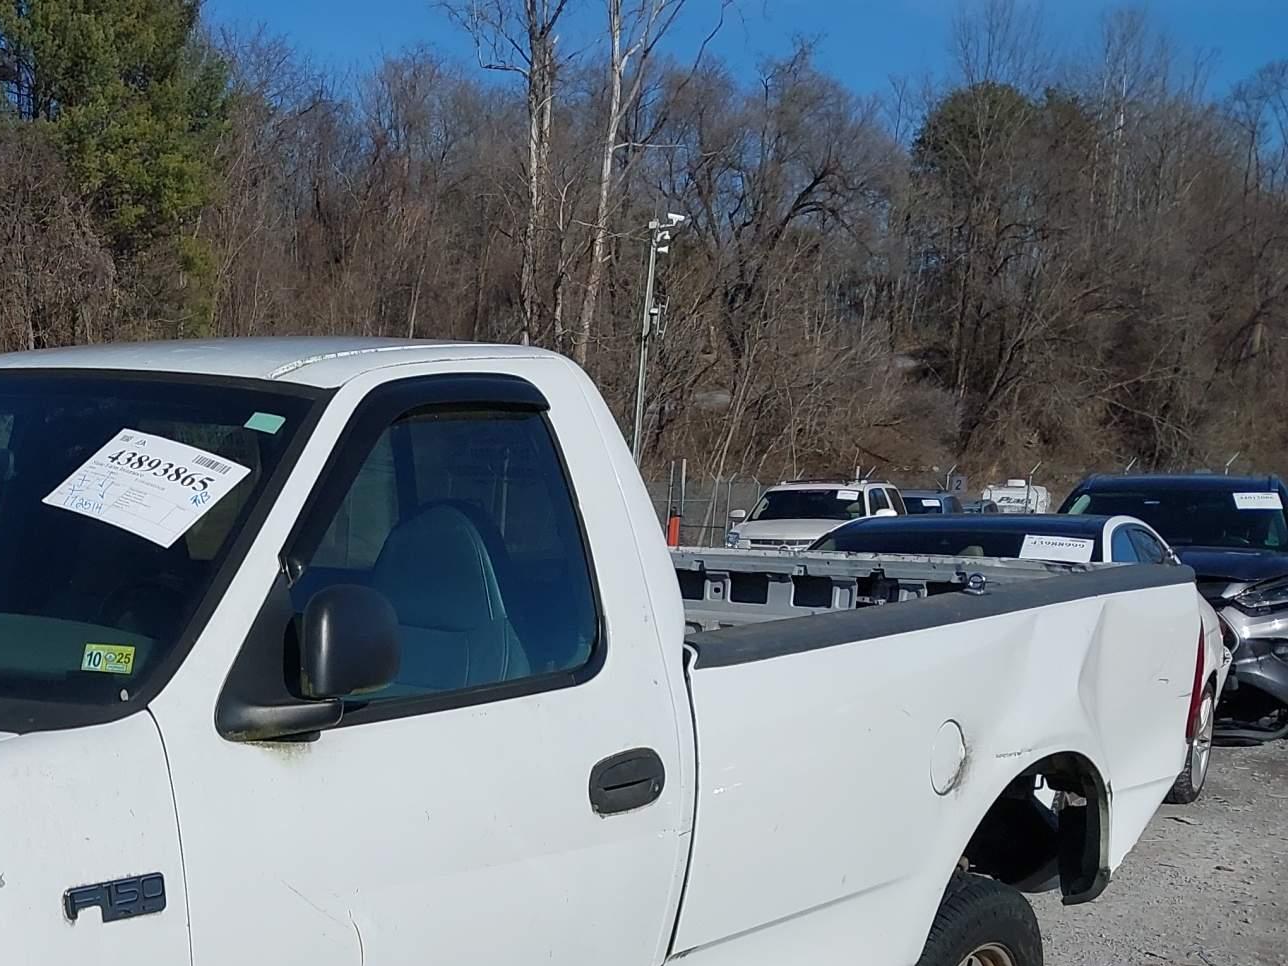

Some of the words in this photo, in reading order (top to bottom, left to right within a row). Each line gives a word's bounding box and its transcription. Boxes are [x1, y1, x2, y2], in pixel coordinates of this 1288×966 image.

[108, 450, 215, 491] 43893865
[955, 480, 962, 490] 2
[87, 651, 102, 667] 10
[116, 653, 132, 664] 25
